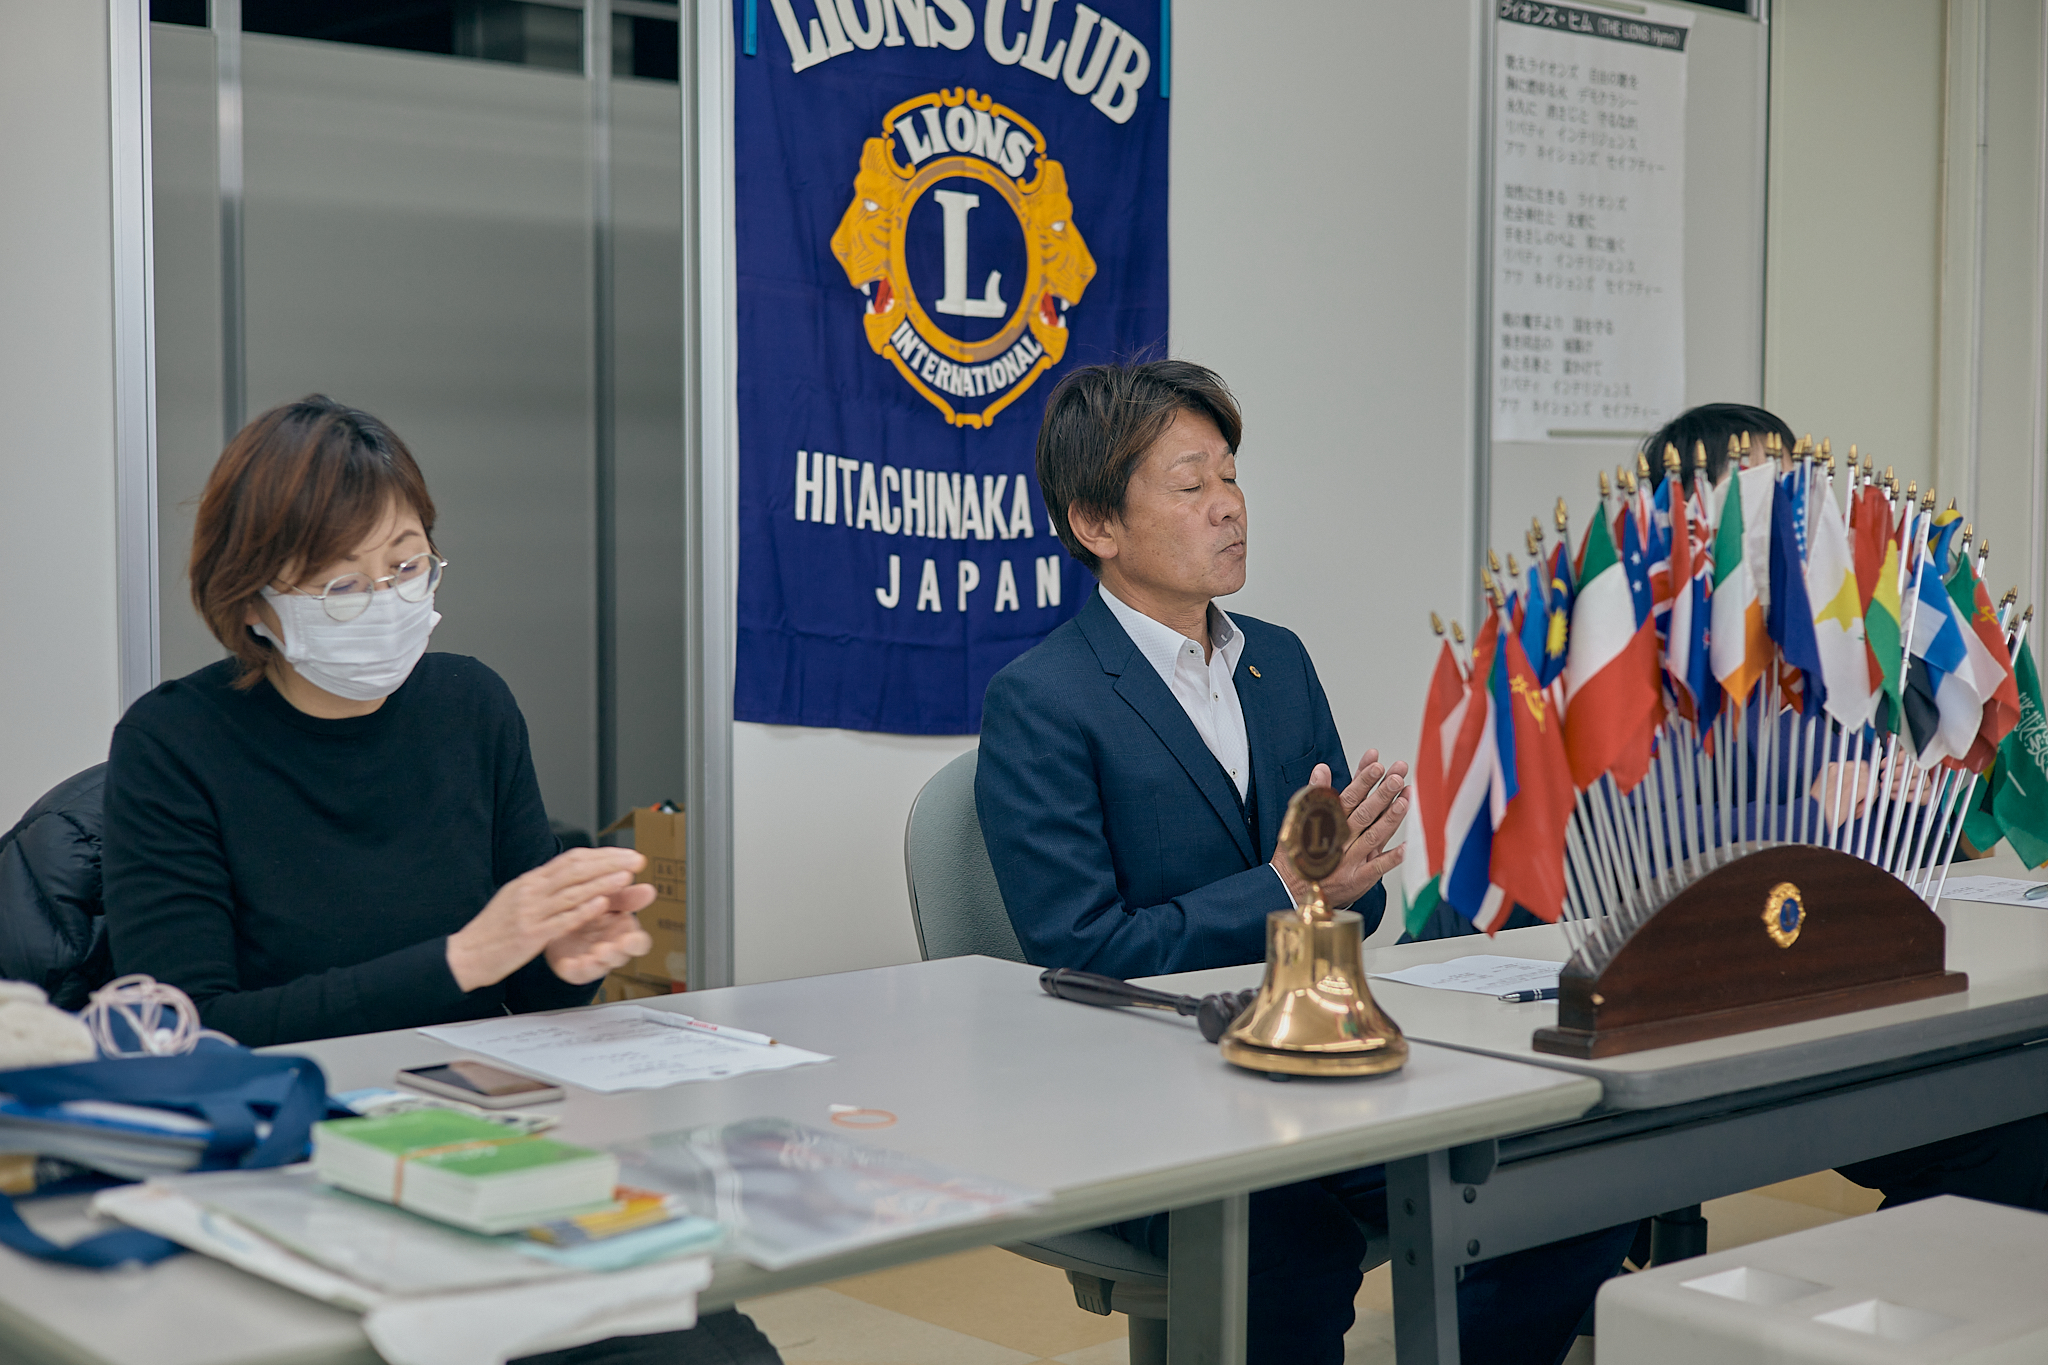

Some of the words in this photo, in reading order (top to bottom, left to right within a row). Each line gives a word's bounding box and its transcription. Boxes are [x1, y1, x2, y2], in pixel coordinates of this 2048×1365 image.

[773, 0, 976, 74] LIONS
[984, 0, 1152, 125] CLUB
[895, 105, 1034, 177] LIONS
[934, 189, 1008, 319] L
[891, 321, 1043, 398] INTERNATIONAL
[795, 450, 1035, 541] HITACHINAKA
[875, 554, 1062, 613] JAPAN
